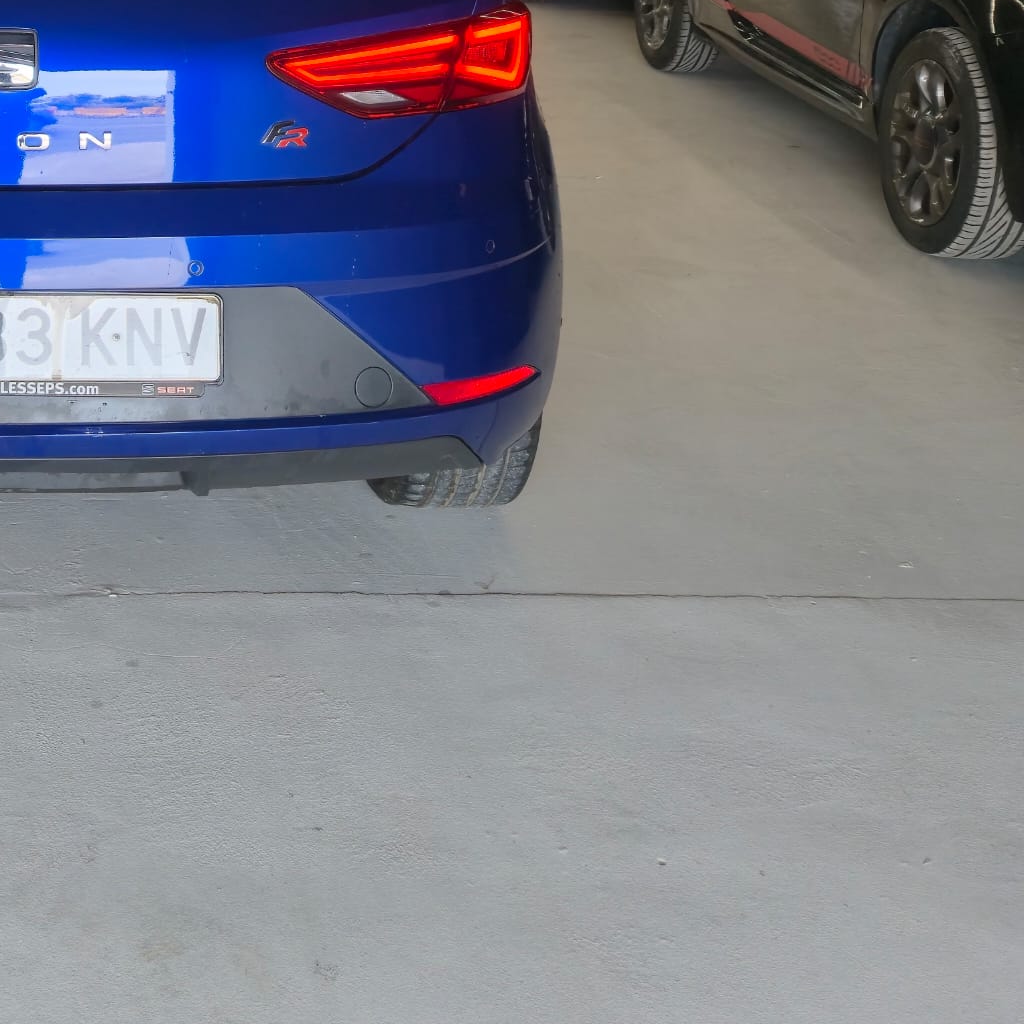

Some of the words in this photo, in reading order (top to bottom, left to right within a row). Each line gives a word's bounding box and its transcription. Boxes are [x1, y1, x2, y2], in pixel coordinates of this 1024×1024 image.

[262, 120, 309, 148] FR
[80, 307, 207, 366] KNV
[0, 381, 99, 395] LESSEPS.com
[157, 386, 195, 394] SEAT
